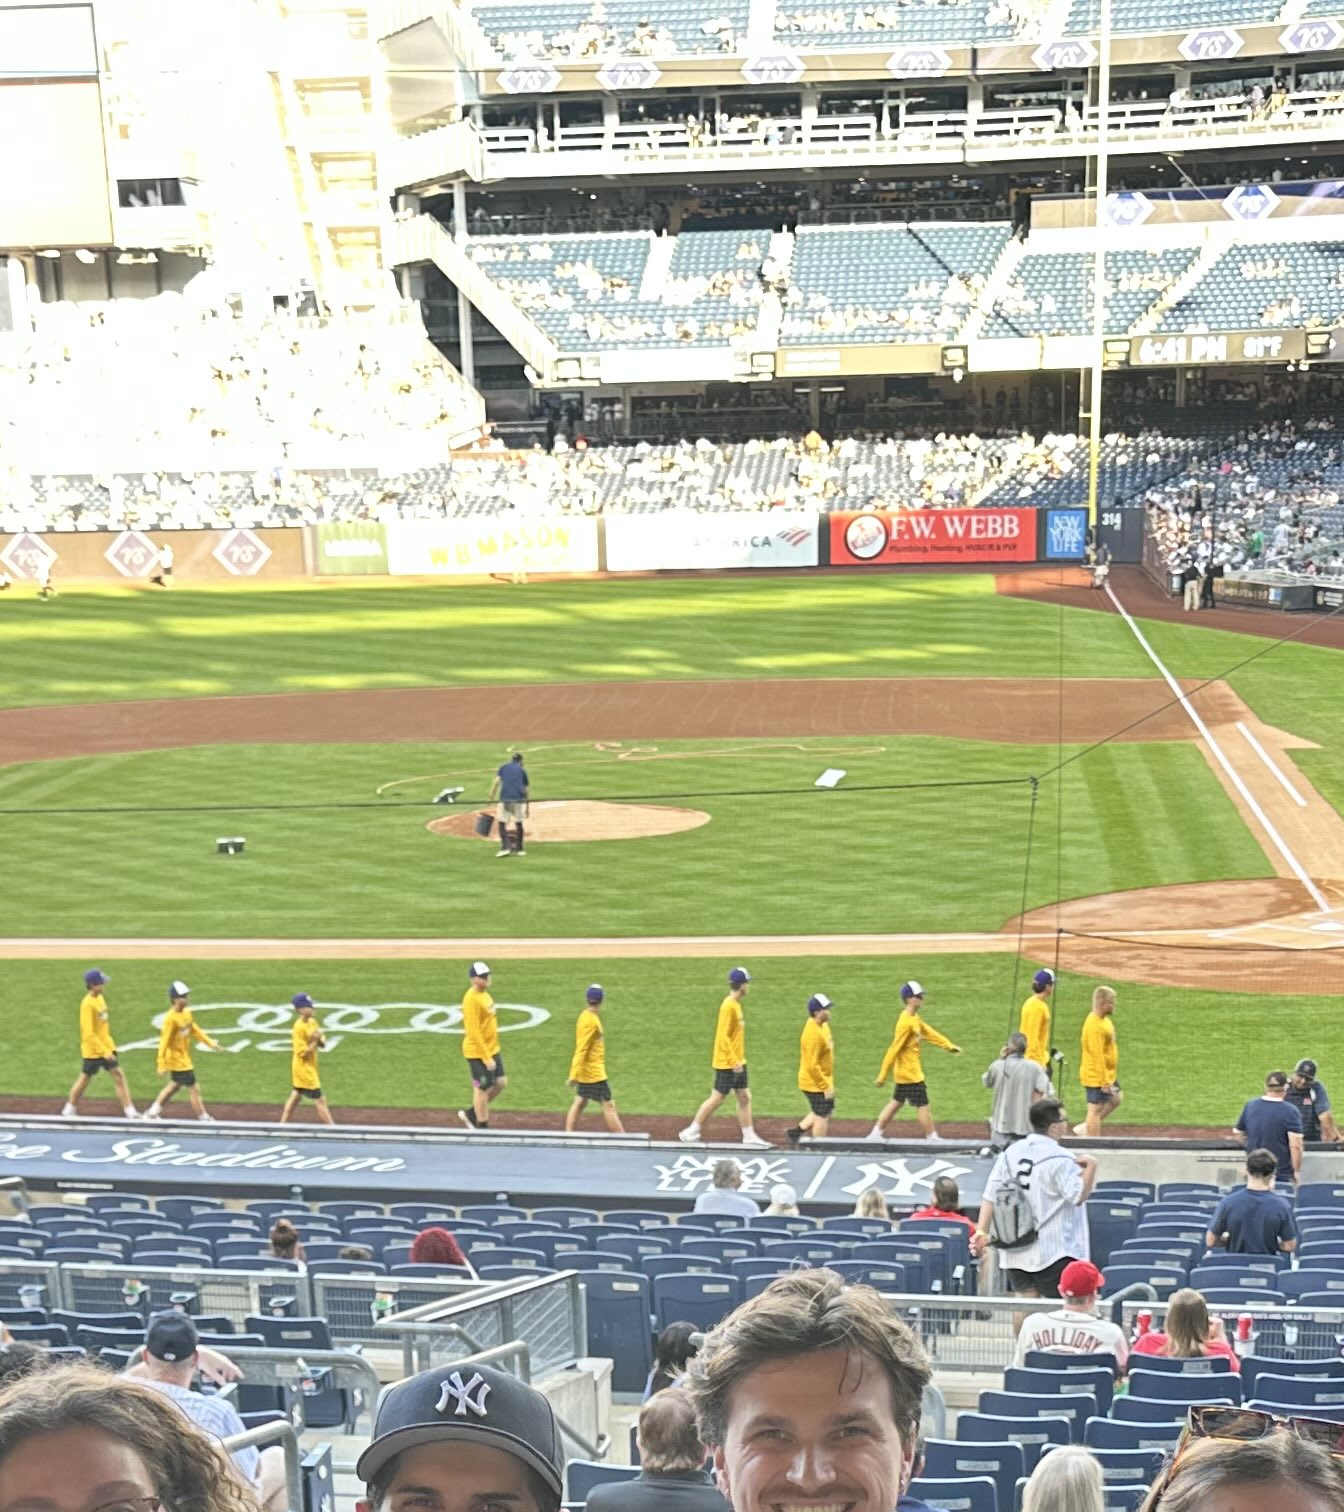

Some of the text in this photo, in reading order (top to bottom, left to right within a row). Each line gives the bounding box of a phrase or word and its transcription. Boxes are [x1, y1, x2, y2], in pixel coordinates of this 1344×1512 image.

[1139, 335, 1194, 361] 6:41
[1196, 334, 1228, 360] PM
[890, 516, 936, 539] F.W.
[942, 514, 1020, 538] WEBB
[1050, 527, 1081, 541] YORK
[1053, 515, 1080, 528] NEW
[1053, 541, 1078, 553] LIFE
[61, 1139, 405, 1172] Stadium
[1017, 1159, 1034, 1190] 2
[1033, 1327, 1103, 1352] HOLLIDAY
[435, 1371, 493, 1418] NY
